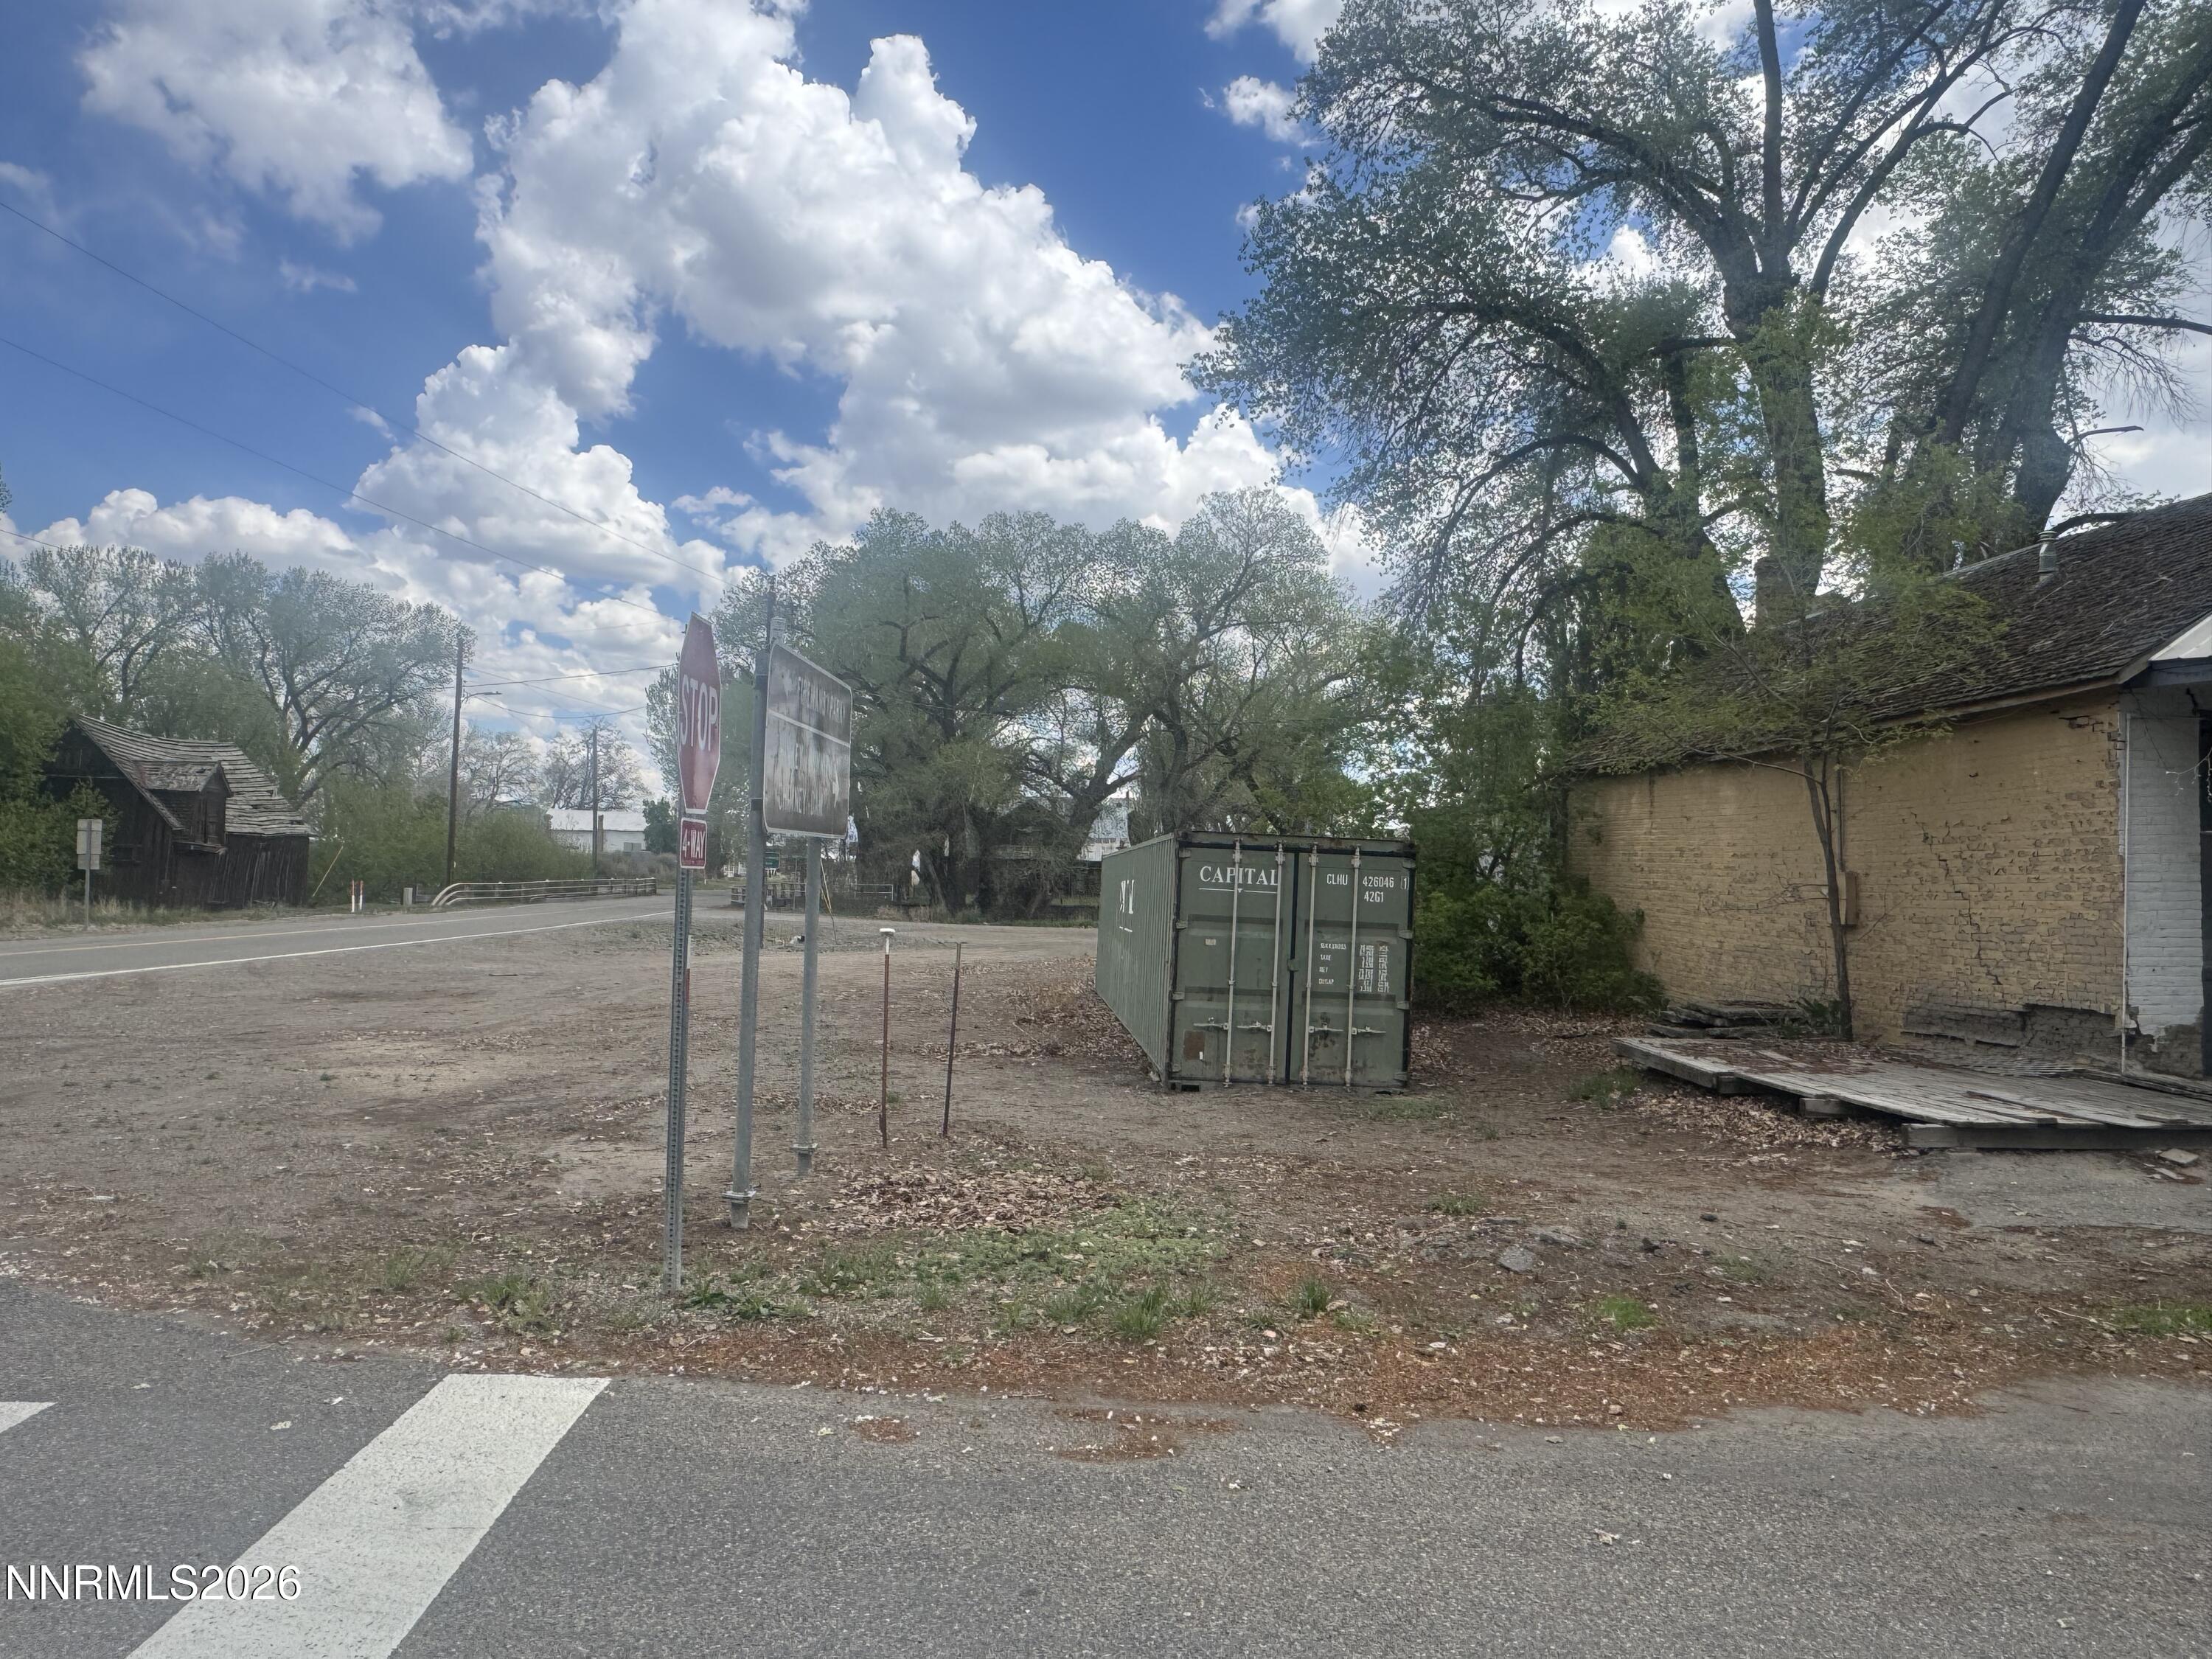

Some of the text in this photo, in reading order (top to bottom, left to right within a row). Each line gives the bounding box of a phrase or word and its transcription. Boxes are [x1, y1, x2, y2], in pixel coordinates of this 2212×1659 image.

[681, 674, 719, 751] STOP
[682, 828, 706, 859] 4-WAY
[1200, 866, 1279, 886] CAPITAL
[1326, 873, 1349, 886] CLHU
[1363, 876, 1394, 888] 426046
[1363, 891, 1384, 902] 42G1
